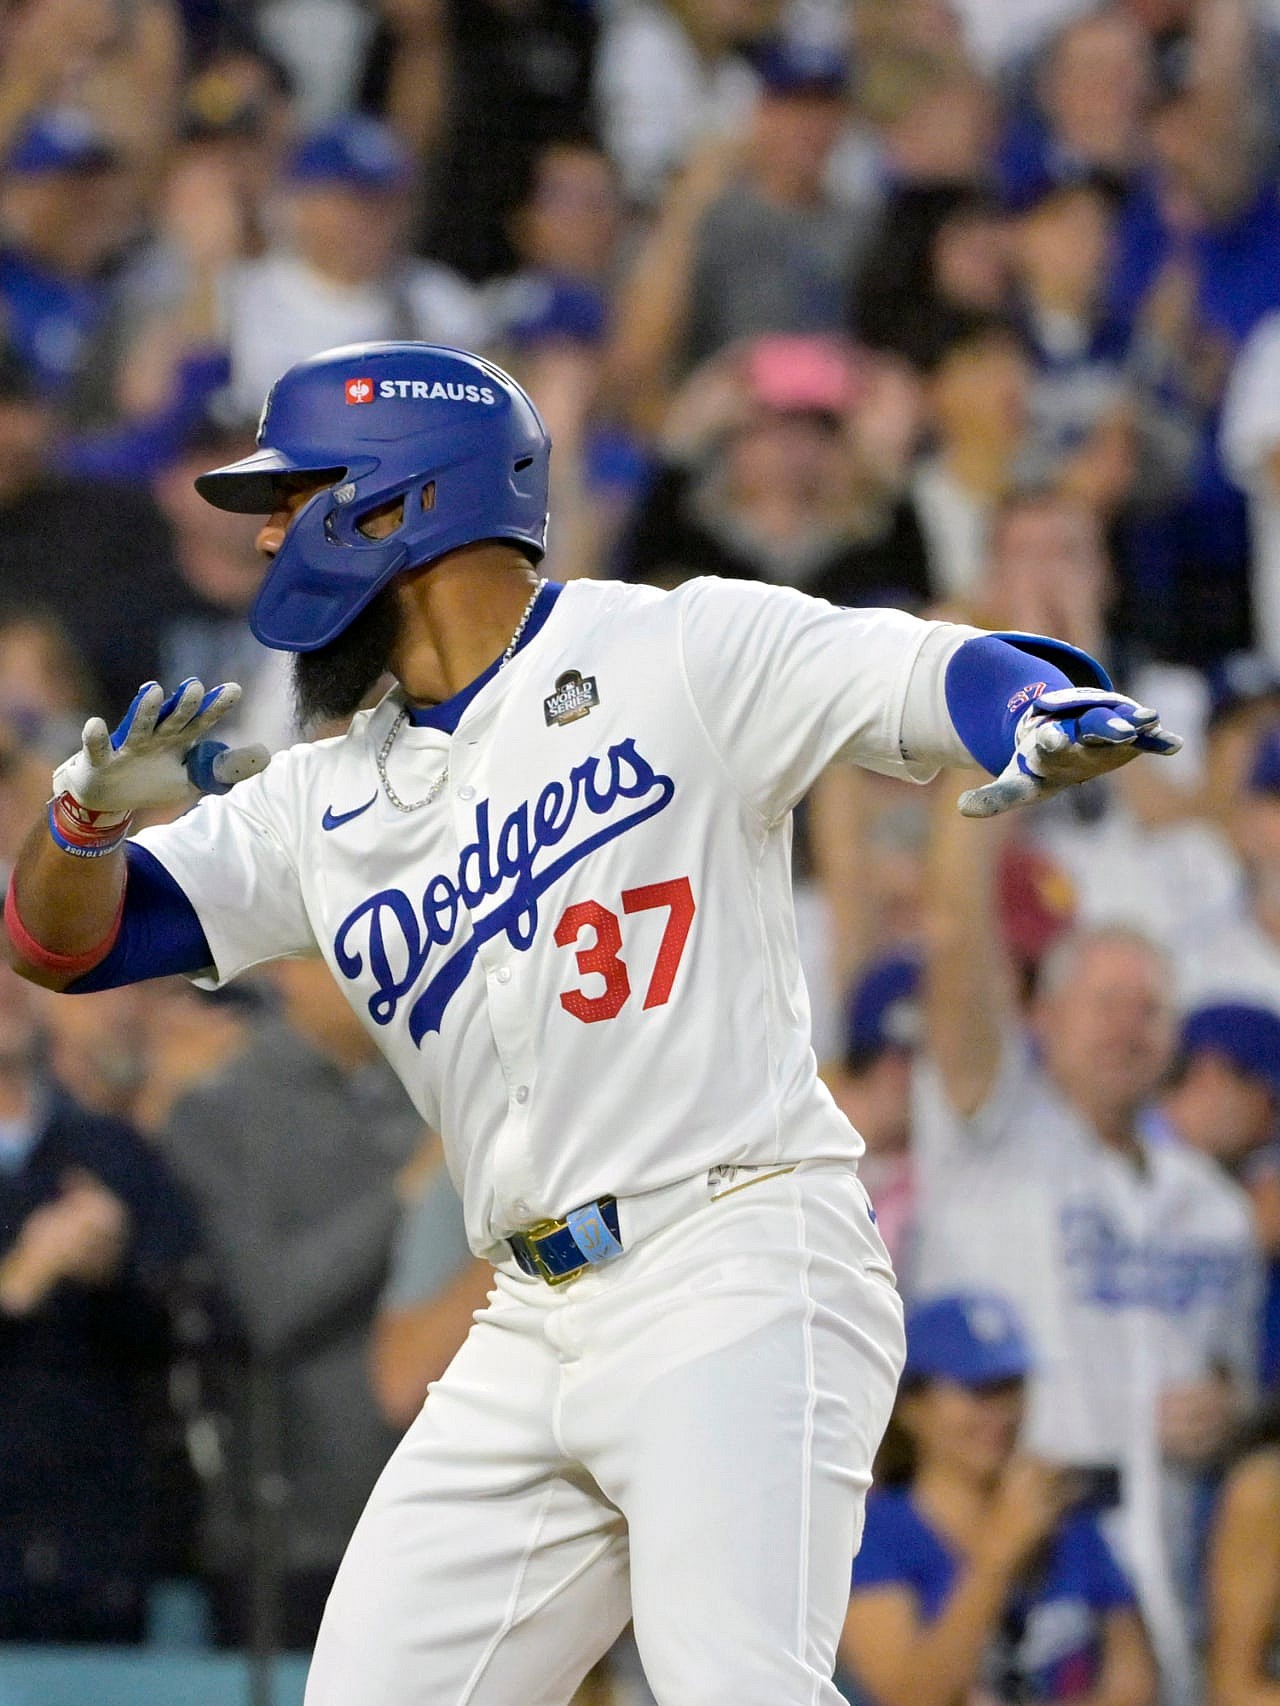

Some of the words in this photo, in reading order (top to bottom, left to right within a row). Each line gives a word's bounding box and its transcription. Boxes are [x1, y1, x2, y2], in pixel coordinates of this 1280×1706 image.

[379, 379, 496, 405] STRAUSS
[546, 682, 593, 710] WORLD
[549, 691, 593, 718] SERIES
[334, 738, 675, 1051] Dodgers
[552, 875, 696, 1025] 37
[576, 1217, 601, 1251] 37
